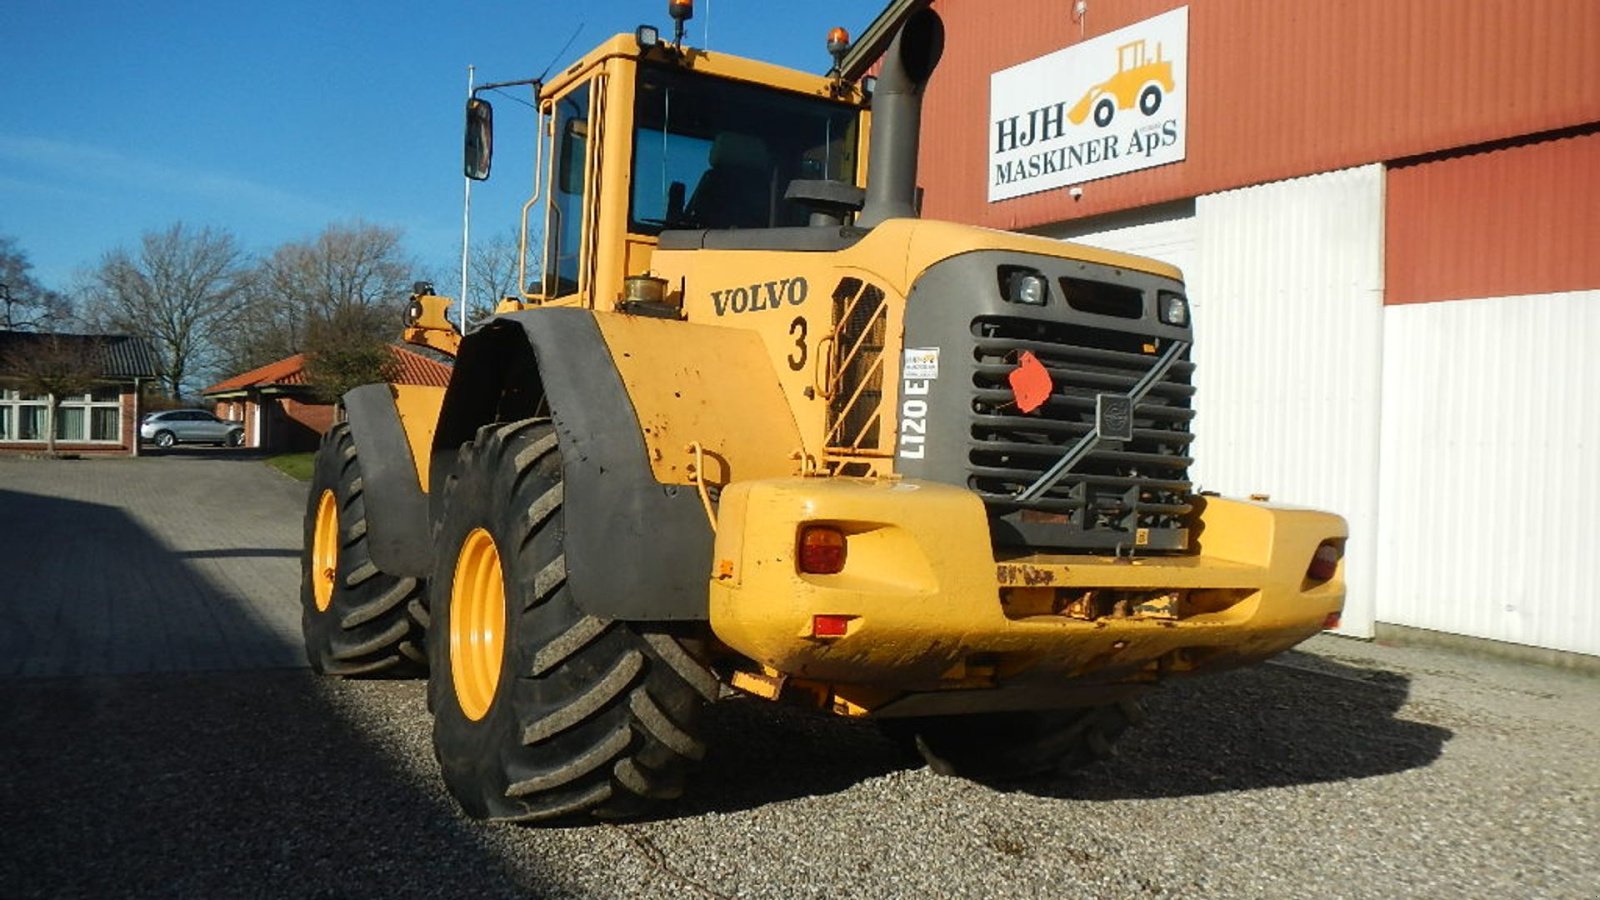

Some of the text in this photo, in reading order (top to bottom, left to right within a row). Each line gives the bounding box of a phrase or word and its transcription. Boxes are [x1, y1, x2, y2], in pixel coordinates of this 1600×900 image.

[995, 101, 1067, 154] HJH
[995, 119, 1178, 186] MASKINER ApS
[710, 276, 808, 317] VOLVO
[787, 316, 808, 371] 3
[900, 399, 928, 459] L120
